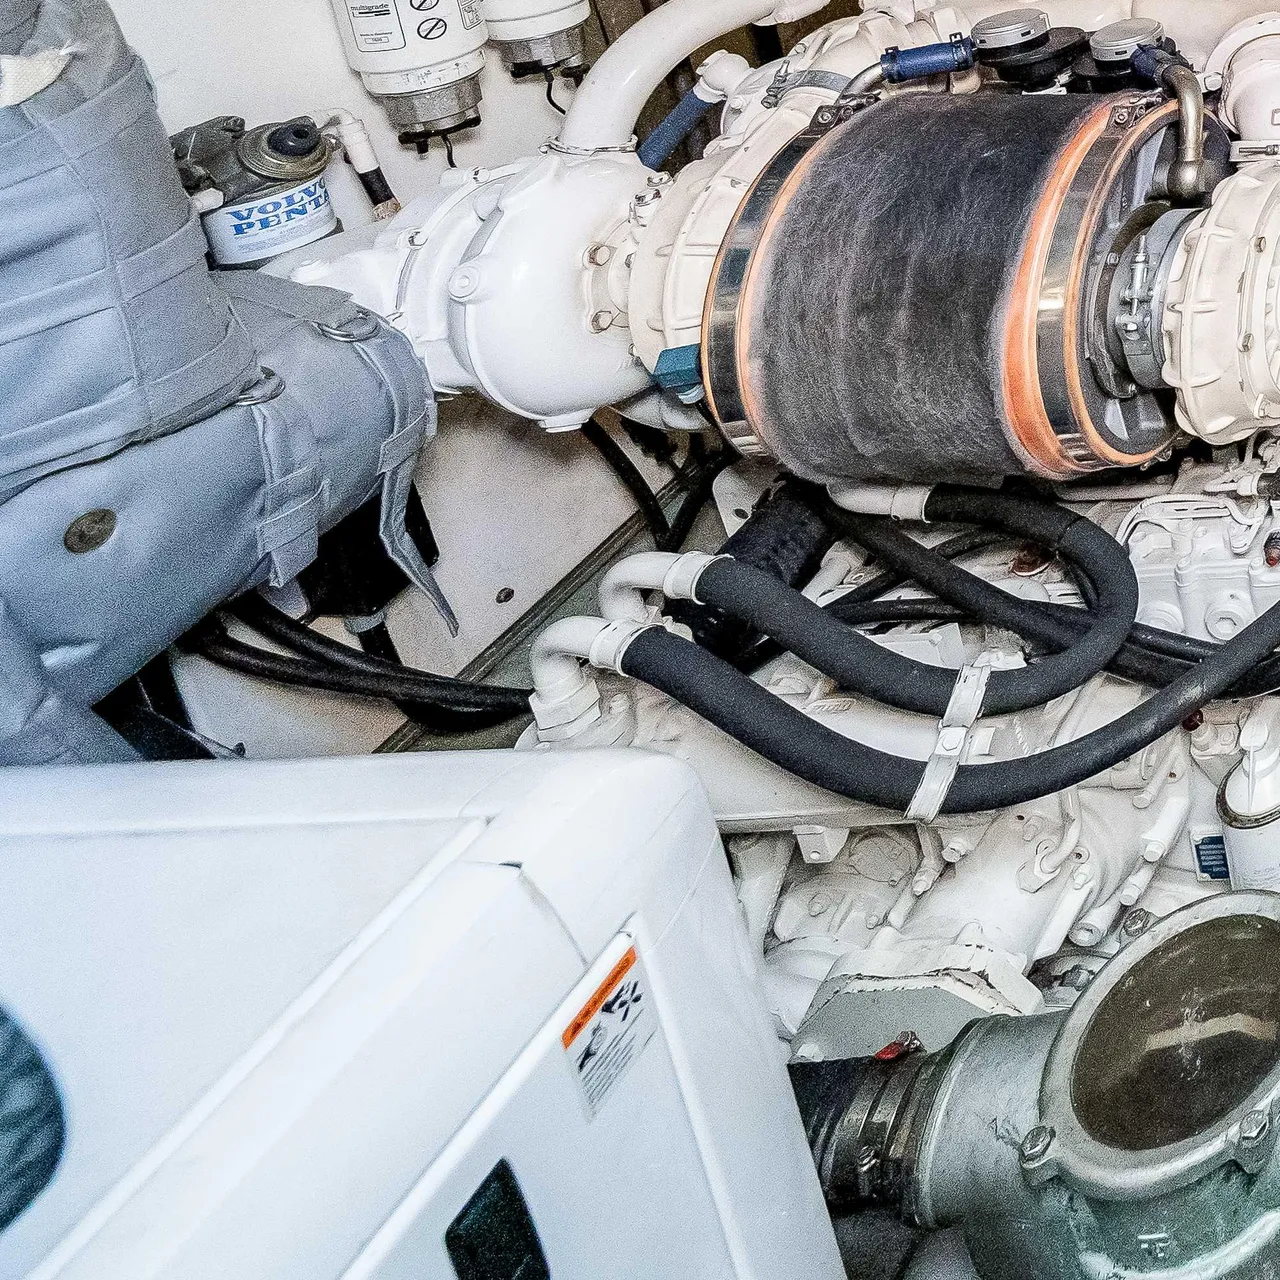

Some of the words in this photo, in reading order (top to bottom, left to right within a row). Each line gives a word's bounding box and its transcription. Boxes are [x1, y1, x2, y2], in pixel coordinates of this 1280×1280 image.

[350, 2, 389, 11] multigrade
[226, 177, 326, 221] VOLVO
[230, 188, 329, 236] PENTA
